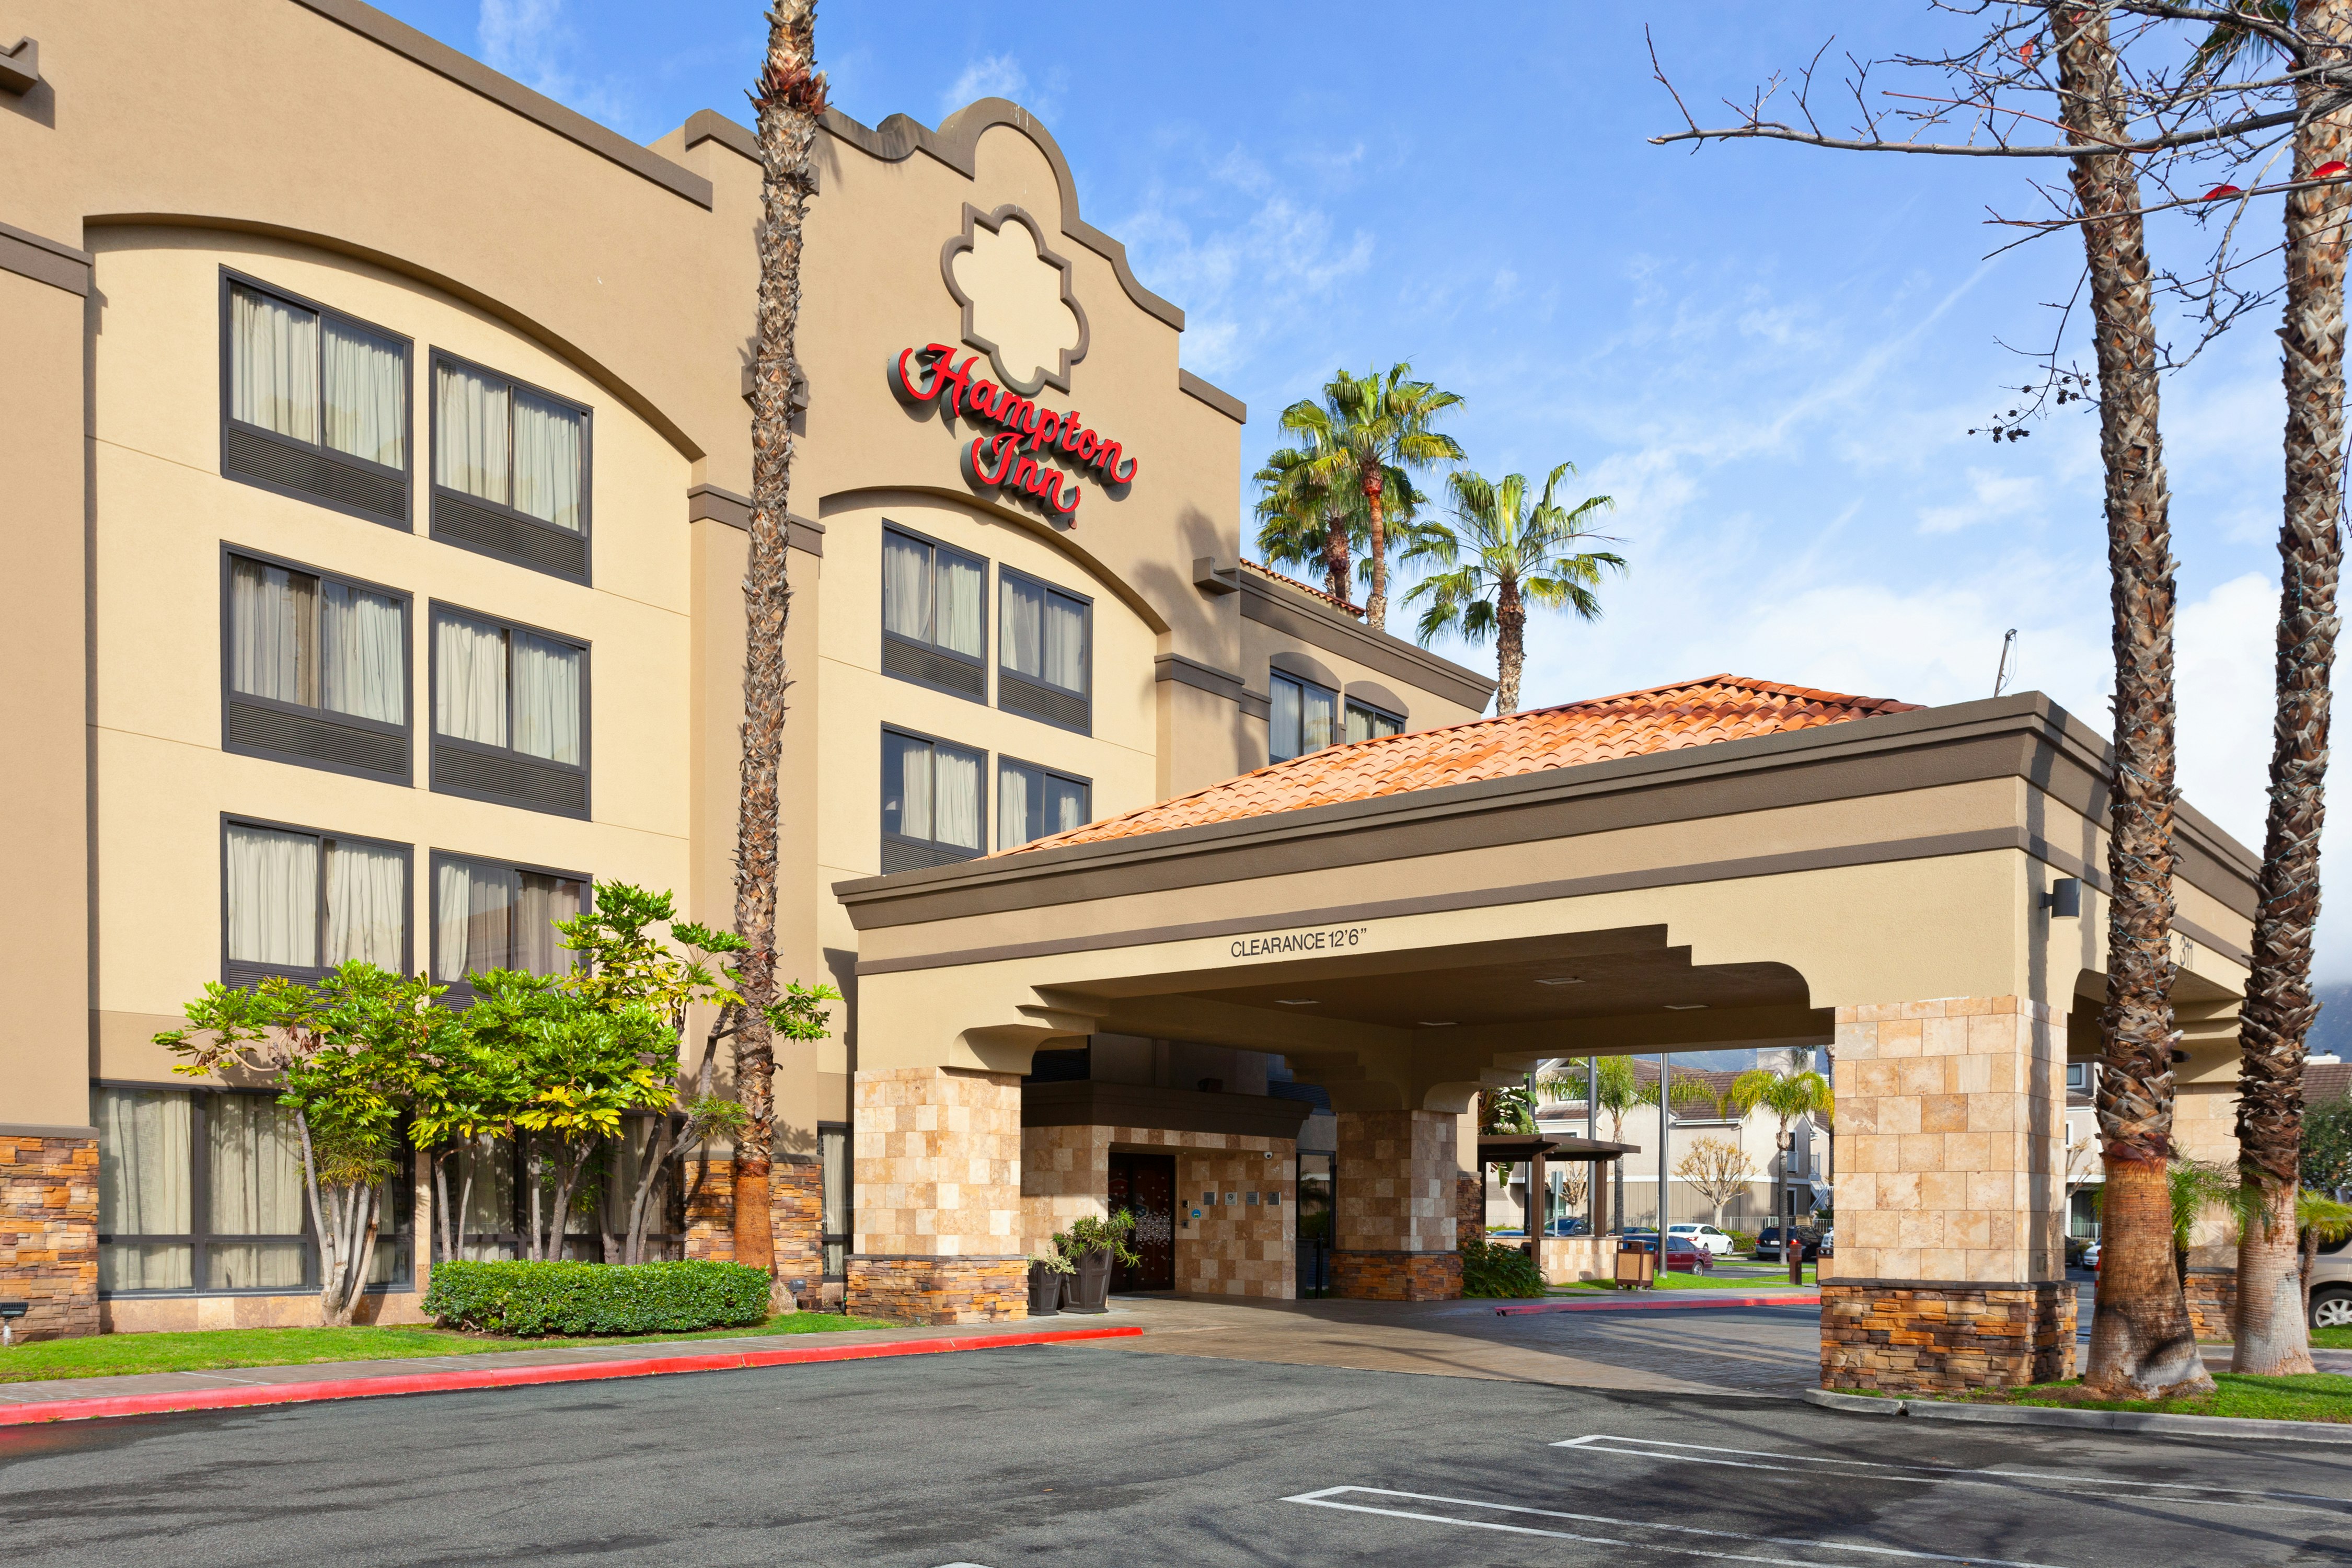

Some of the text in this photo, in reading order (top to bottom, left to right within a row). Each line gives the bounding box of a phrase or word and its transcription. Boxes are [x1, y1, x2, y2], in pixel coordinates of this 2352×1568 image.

[898, 343, 1137, 483] Hampton
[971, 432, 1081, 513] Inn
[1231, 932, 1325, 958] CLEARANCE
